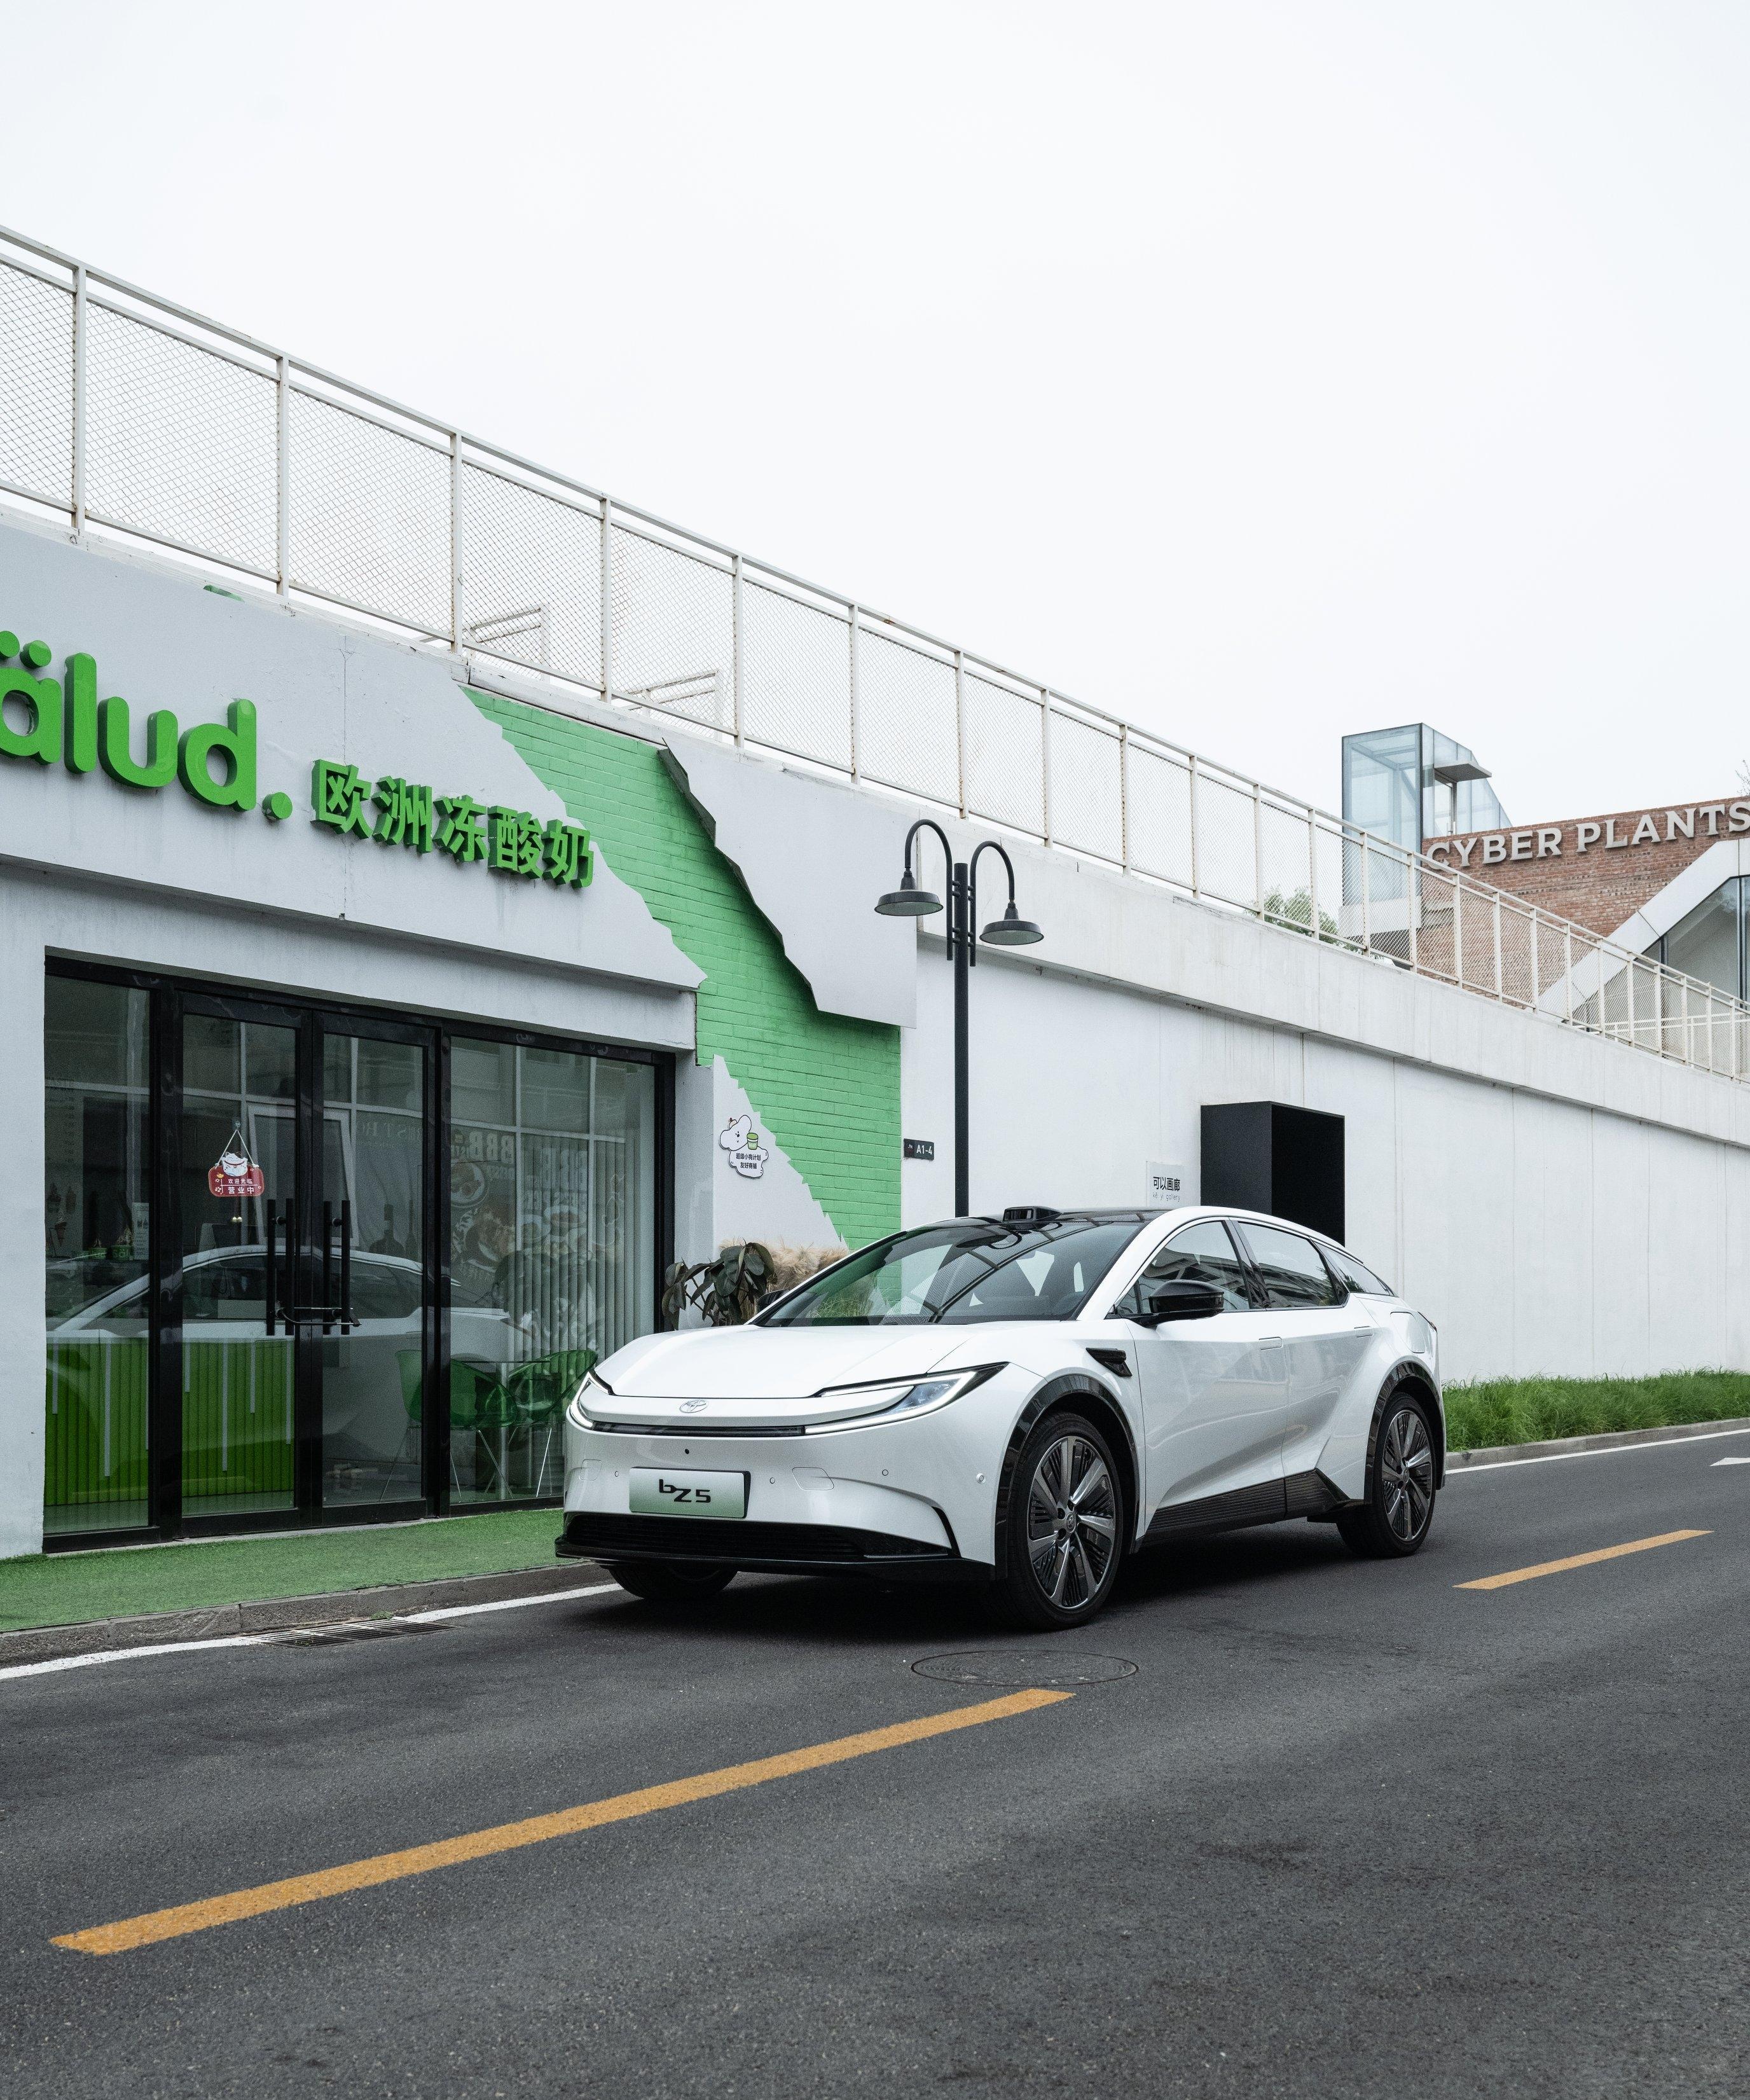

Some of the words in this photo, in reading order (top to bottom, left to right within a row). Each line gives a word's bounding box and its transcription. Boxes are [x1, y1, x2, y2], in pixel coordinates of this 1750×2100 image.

[310, 759, 595, 888] 欧洲冻酸奶
[1426, 827, 1562, 870] CYBER
[1576, 802, 1750, 852] PLANTS
[916, 1144, 933, 1155] A1-4
[736, 1152, 761, 1161] 超级小狗计划
[228, 1186, 254, 1194] 营业中
[1153, 1177, 1180, 1192] 可以画廊
[1166, 1193, 1180, 1203] gallery
